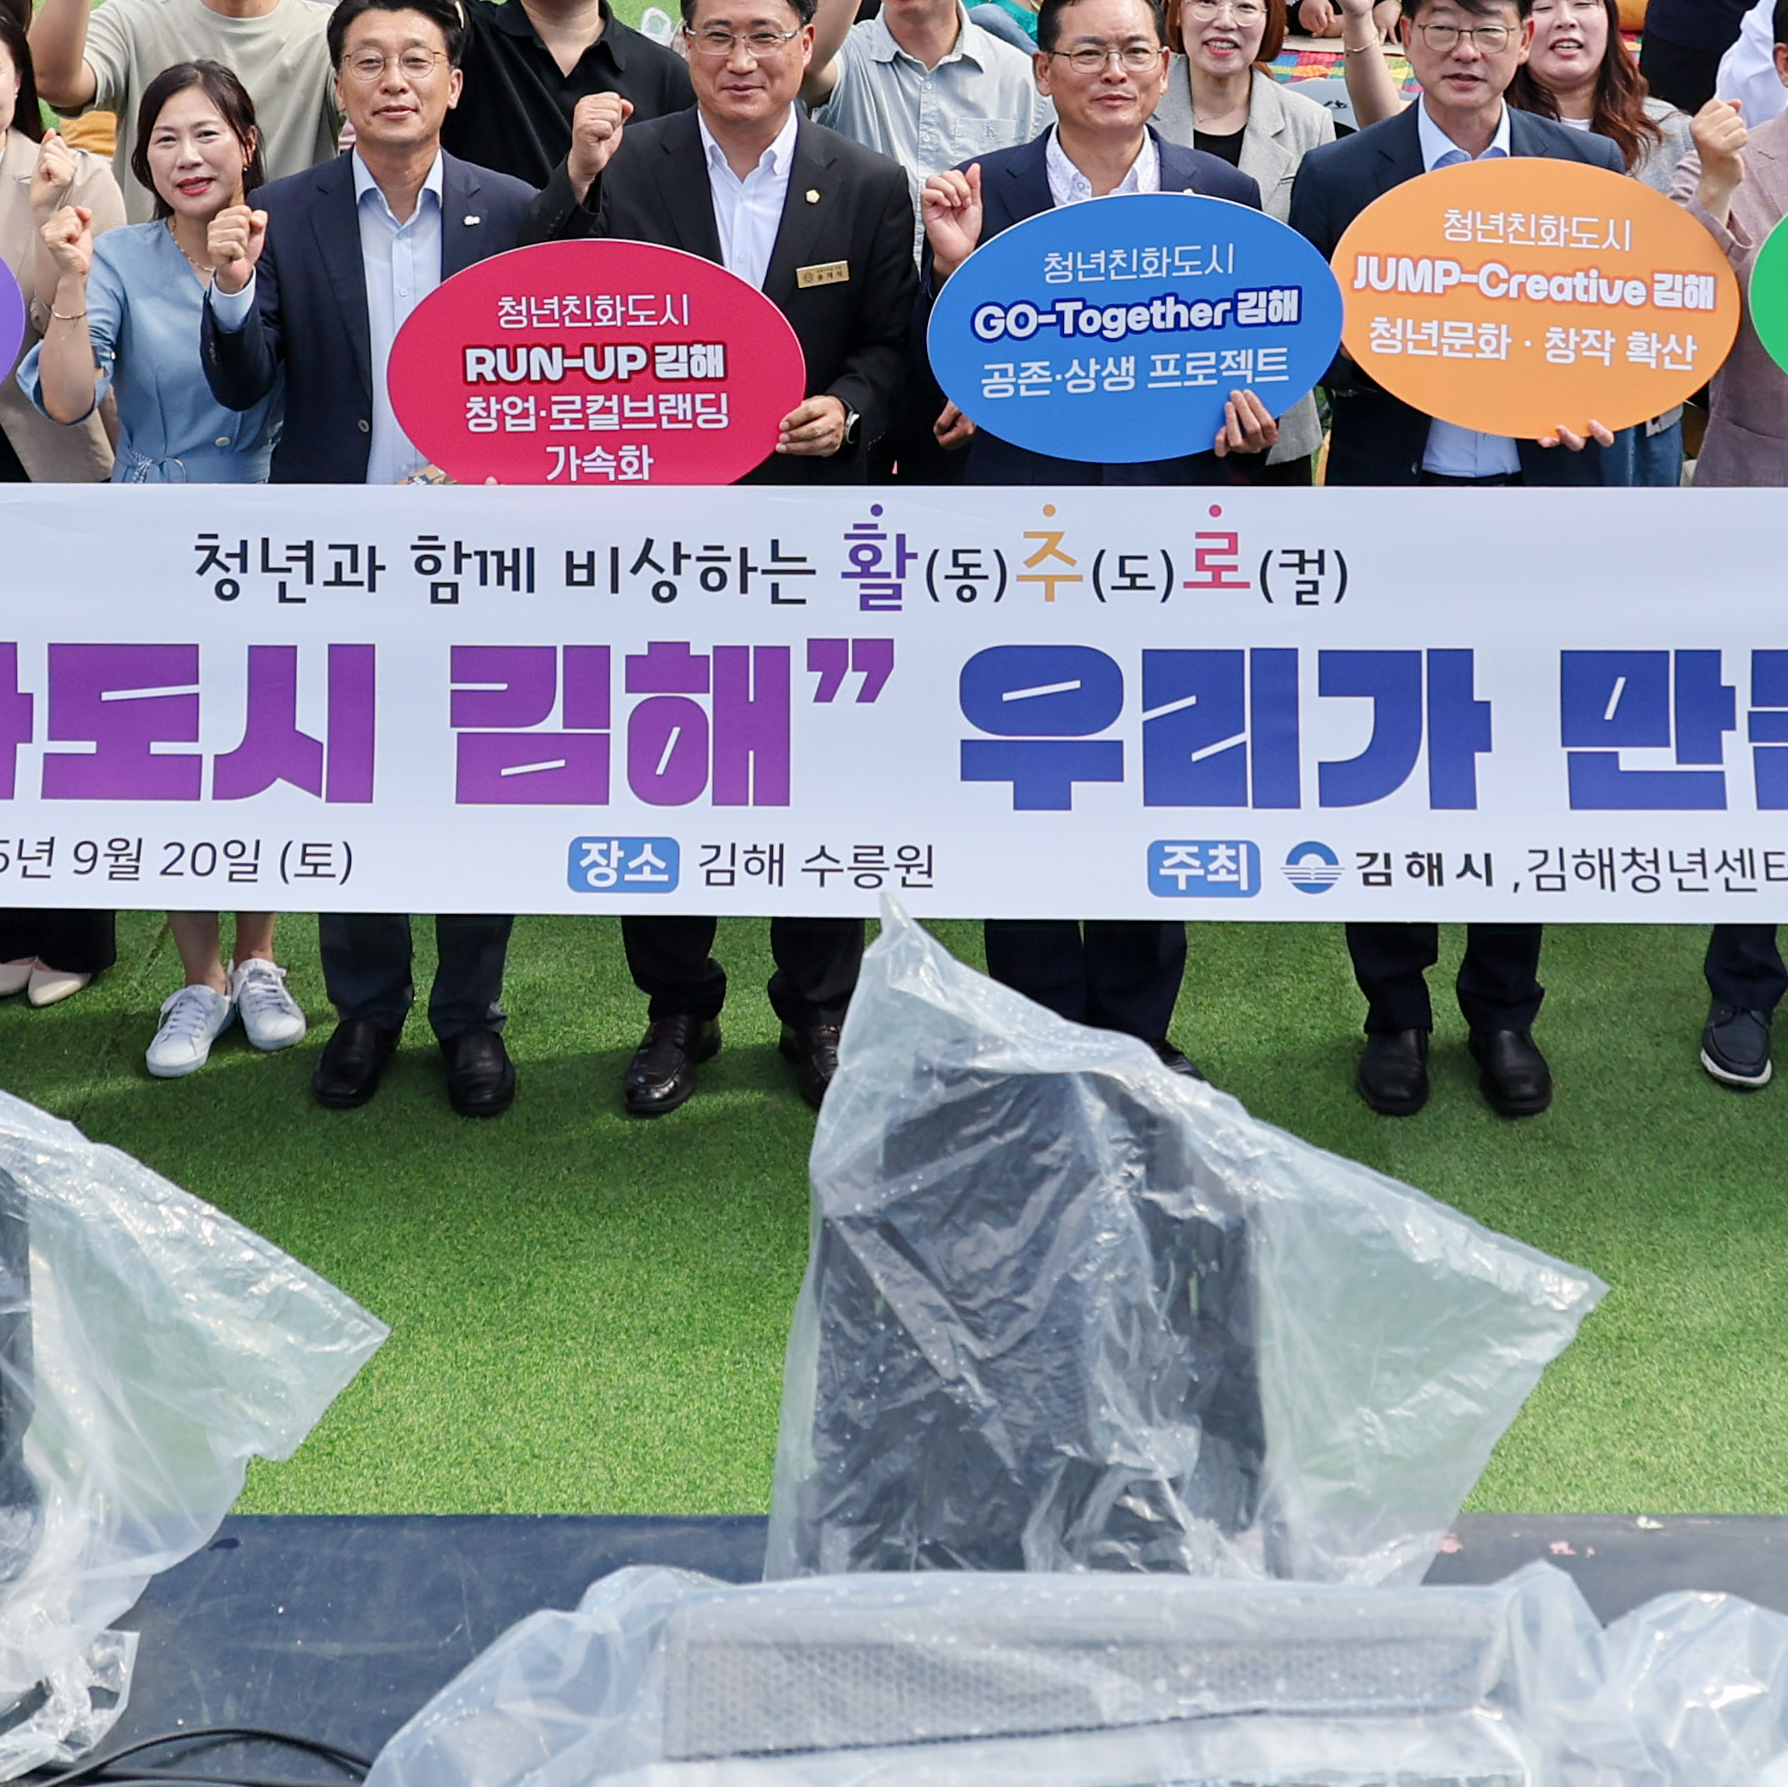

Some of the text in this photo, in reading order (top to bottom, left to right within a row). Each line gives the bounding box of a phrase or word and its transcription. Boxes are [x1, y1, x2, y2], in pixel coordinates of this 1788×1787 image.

[1442, 207, 1633, 254] 청년친화도시
[1042, 242, 1235, 285] 청년친화도시
[1352, 257, 1717, 313] JUMP-Creative 김해
[496, 293, 691, 331] 청년친화도시
[972, 287, 1300, 342] GO-Together 김해
[463, 343, 726, 383] RUN-UP 김해
[1368, 314, 1697, 374] 청년문화 창작 확산
[980, 346, 1291, 400] 공존·상생 프로젝트
[464, 392, 731, 434] 창업·로컬브랜딩
[544, 444, 654, 484] 가속화
[194, 532, 386, 605] 청년과
[409, 534, 536, 605] 함께
[564, 536, 817, 605] 비상하는
[958, 644, 1492, 812] 우리가
[68, 836, 144, 882] 9월
[157, 837, 265, 883] 20일
[278, 837, 356, 887] (토)
[577, 839, 938, 890] 장소 김해 수릉원
[1159, 843, 1253, 892] 주최
